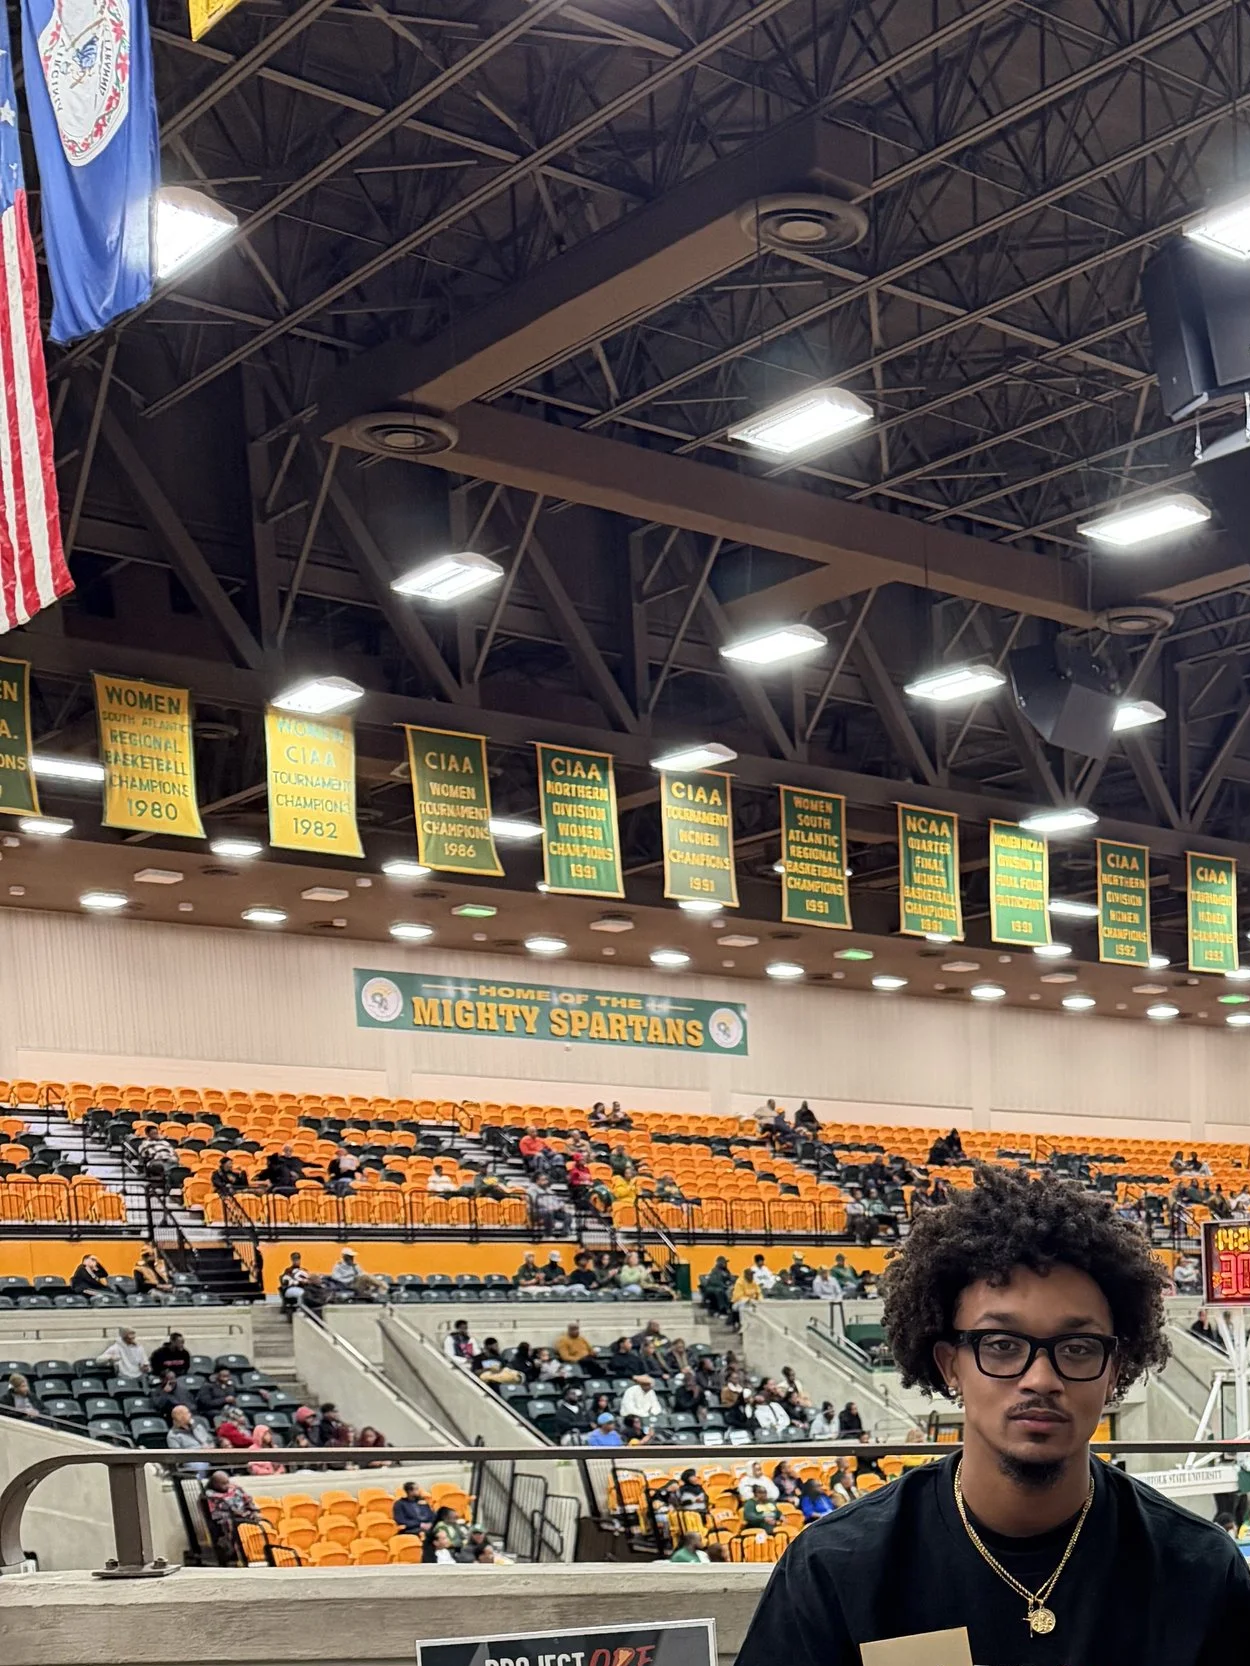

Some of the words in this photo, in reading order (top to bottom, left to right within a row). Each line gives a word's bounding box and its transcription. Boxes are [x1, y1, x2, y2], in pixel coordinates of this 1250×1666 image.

[104, 686, 181, 715] WOMEN
[101, 711, 136, 726] SOUTH
[110, 729, 183, 754] REGIONAL
[104, 750, 188, 776] BASKETBALL
[286, 746, 336, 767] CIAA
[424, 752, 475, 774] CIAA
[551, 757, 602, 781] CIAA
[109, 773, 191, 797] CHAMPIONS
[272, 770, 351, 791] TOURNAMENT
[429, 782, 476, 800] WOMEN
[546, 780, 609, 802] NORTHERN
[671, 781, 722, 806] CIAA
[128, 798, 178, 820] 1980
[276, 794, 351, 815] CHAMPIONS
[419, 801, 489, 820] TOURNAMENT
[552, 802, 606, 821] DIVISION
[793, 796, 833, 814] WOMEN
[666, 805, 729, 827] TOURNAMENT
[797, 814, 832, 830] SOUTH
[905, 815, 950, 838] NCAA
[293, 817, 338, 839] 1982
[423, 820, 490, 840] CHAMPIONS
[557, 823, 603, 841] WOMEN
[679, 829, 720, 847] WOMEN
[788, 829, 840, 848] ATLANTIC
[444, 843, 476, 858] 1986
[549, 841, 614, 862] CHAMPIONS
[789, 845, 839, 864] REGIONAL
[908, 836, 951, 855] QUARTER
[668, 849, 731, 870] CHAMPIONS
[914, 855, 945, 872] FINAL
[1106, 853, 1140, 871] CIAA
[570, 864, 597, 880] 1991
[785, 860, 845, 881] BASKETBALL
[1196, 866, 1229, 885] CIAA
[690, 876, 715, 893] 1991
[787, 876, 844, 897] CHAMPIONS
[805, 899, 829, 914] 1991
[478, 985, 552, 1002] HOME
[558, 991, 590, 1005] OF
[594, 995, 643, 1010] THE
[411, 996, 541, 1034] MIGHTY
[548, 1009, 704, 1048] SPARTANS
